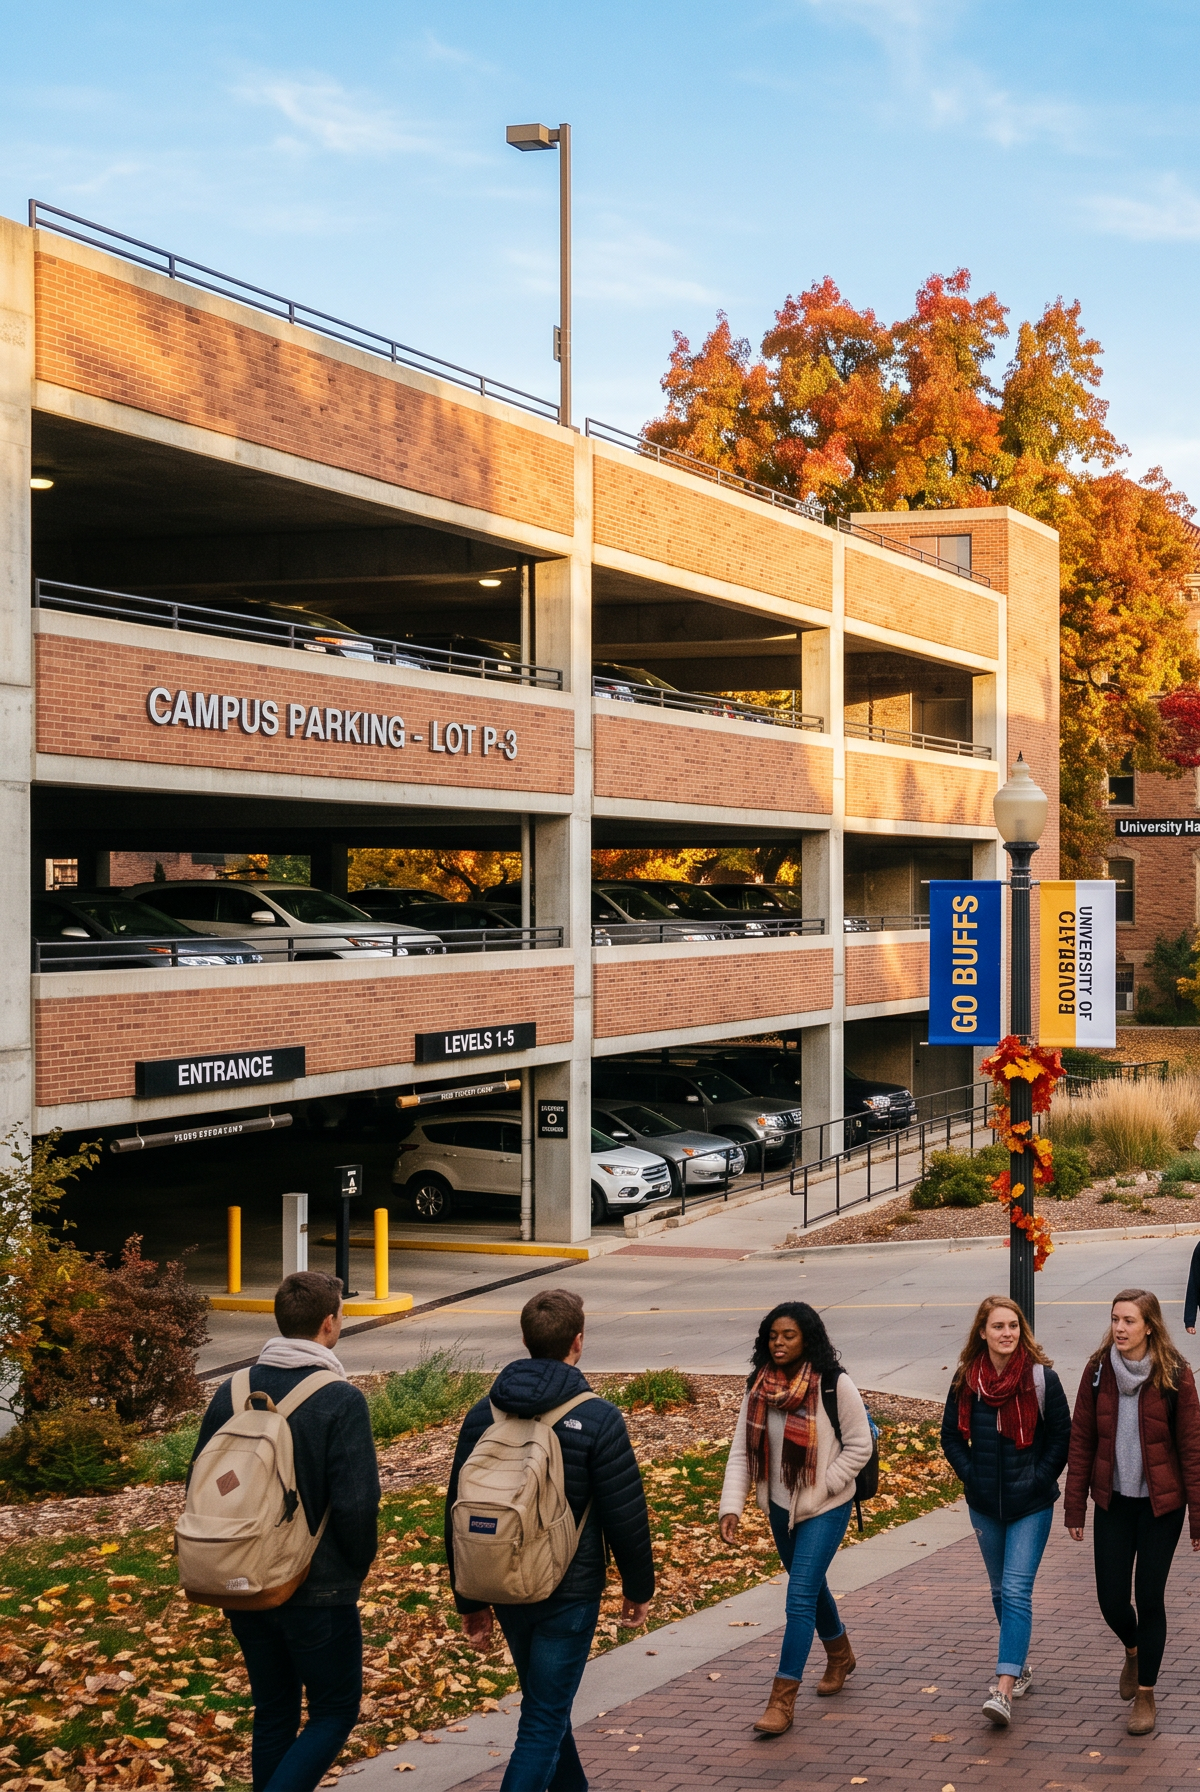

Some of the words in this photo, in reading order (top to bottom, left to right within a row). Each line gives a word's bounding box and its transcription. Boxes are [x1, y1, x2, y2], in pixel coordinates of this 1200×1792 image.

[148, 686, 280, 737] CAMPUS
[288, 703, 405, 749] PARKING
[431, 720, 477, 754] LOT
[483, 726, 518, 760] P-3
[1119, 820, 1183, 836] University
[952, 895, 979, 985] BUFFS
[1078, 906, 1093, 995] UNIVERSITY
[951, 995, 978, 1033] GO
[1078, 1001, 1093, 1021] OF
[444, 1031, 493, 1054] LEVELS
[495, 1029, 515, 1048] 1-5
[178, 1055, 273, 1086] ENTRANCE
